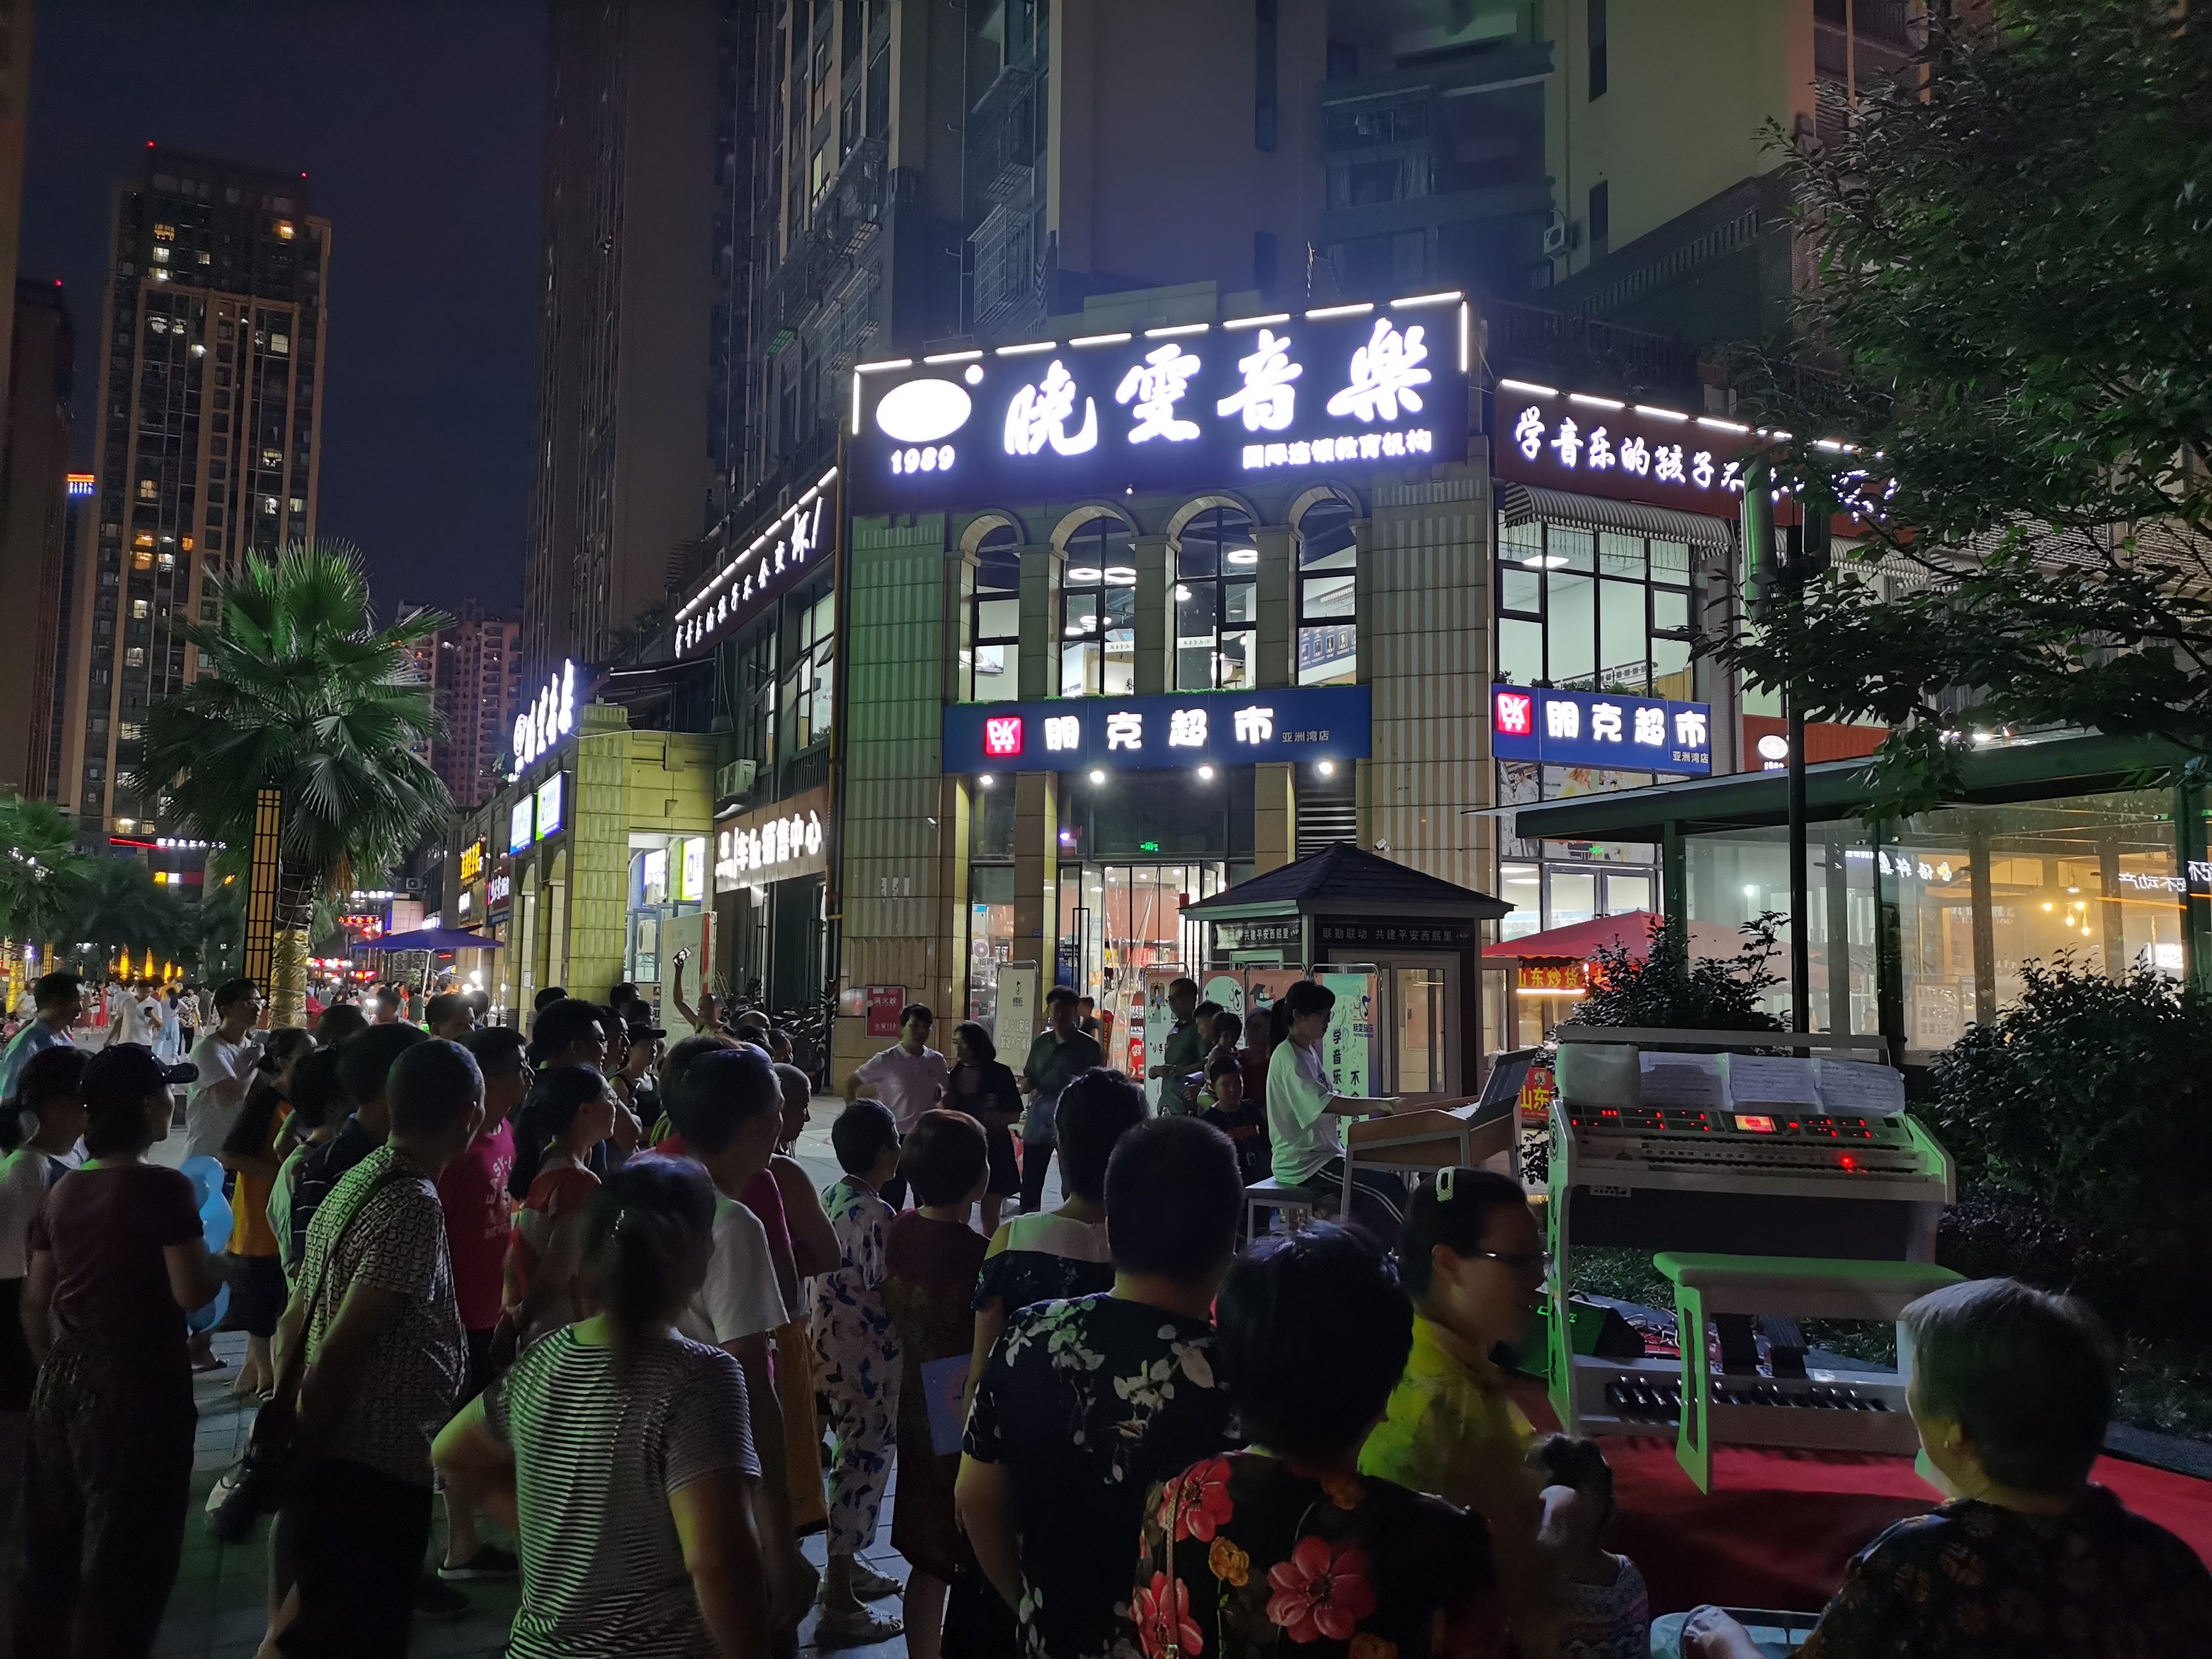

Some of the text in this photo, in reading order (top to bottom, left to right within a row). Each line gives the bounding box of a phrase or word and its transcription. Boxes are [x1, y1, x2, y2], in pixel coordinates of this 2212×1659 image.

[891, 444, 955, 474] 1989
[1242, 428, 1432, 469] 国际连锁教育机构
[1044, 705, 1274, 750] 朋克超市
[1281, 729, 1330, 743] 亚洲湾店
[1546, 700, 1707, 748] 朋克超市
[1672, 751, 1709, 765] 亚洲湾店
[1322, 927, 1452, 942] 联勤联动 共建平安西熙里
[1518, 968, 1579, 988] 山东炒货
